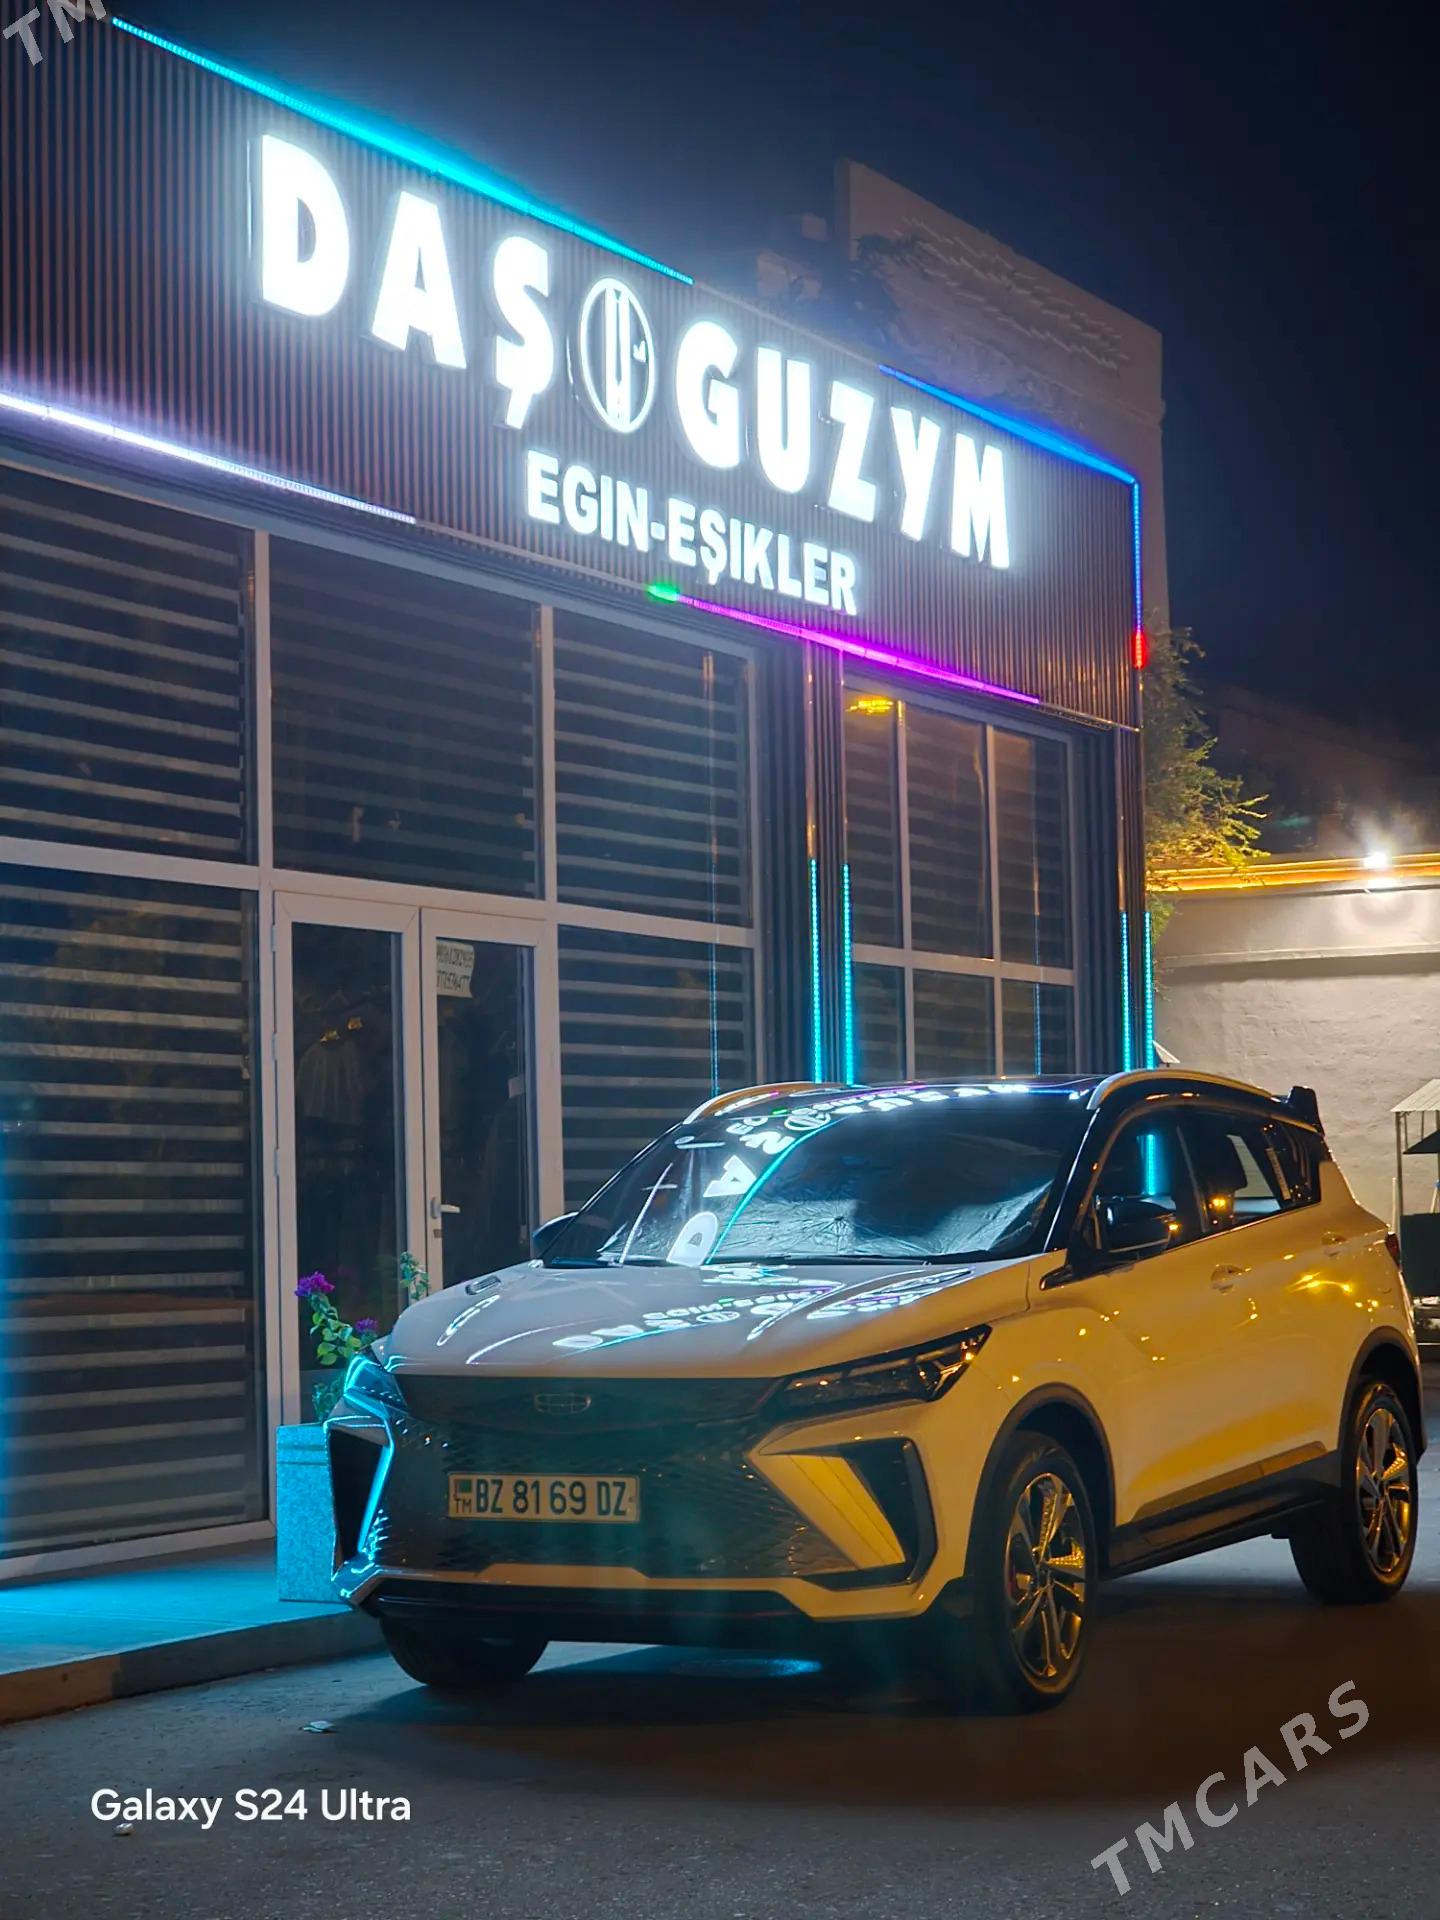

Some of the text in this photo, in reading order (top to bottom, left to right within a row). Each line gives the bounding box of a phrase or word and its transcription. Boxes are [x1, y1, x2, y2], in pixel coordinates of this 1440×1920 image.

[526, 450, 859, 616] EGIN-EŞIKLER
[455, 1498, 473, 1513] TM
[476, 1478, 504, 1514] BZ
[596, 1481, 628, 1517] DZ
